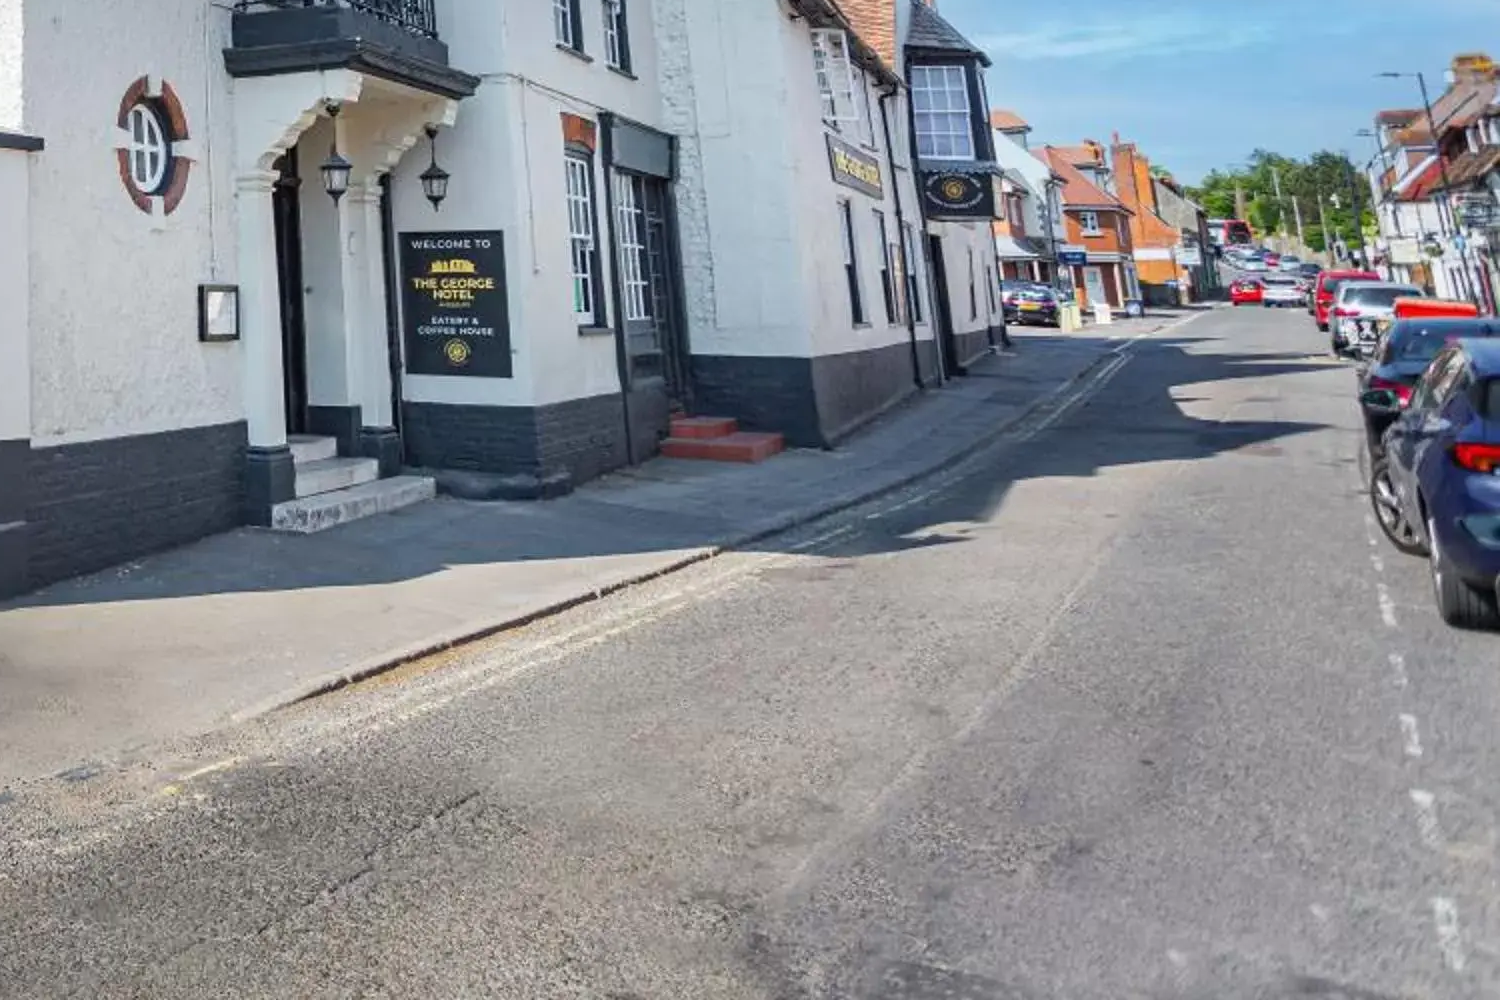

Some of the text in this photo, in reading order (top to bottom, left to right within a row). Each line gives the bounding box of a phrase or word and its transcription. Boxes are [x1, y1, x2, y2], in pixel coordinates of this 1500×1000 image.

[411, 239, 491, 249] WELCOME TO
[412, 277, 494, 289] THE GEORGE
[433, 289, 474, 300] HOTEL
